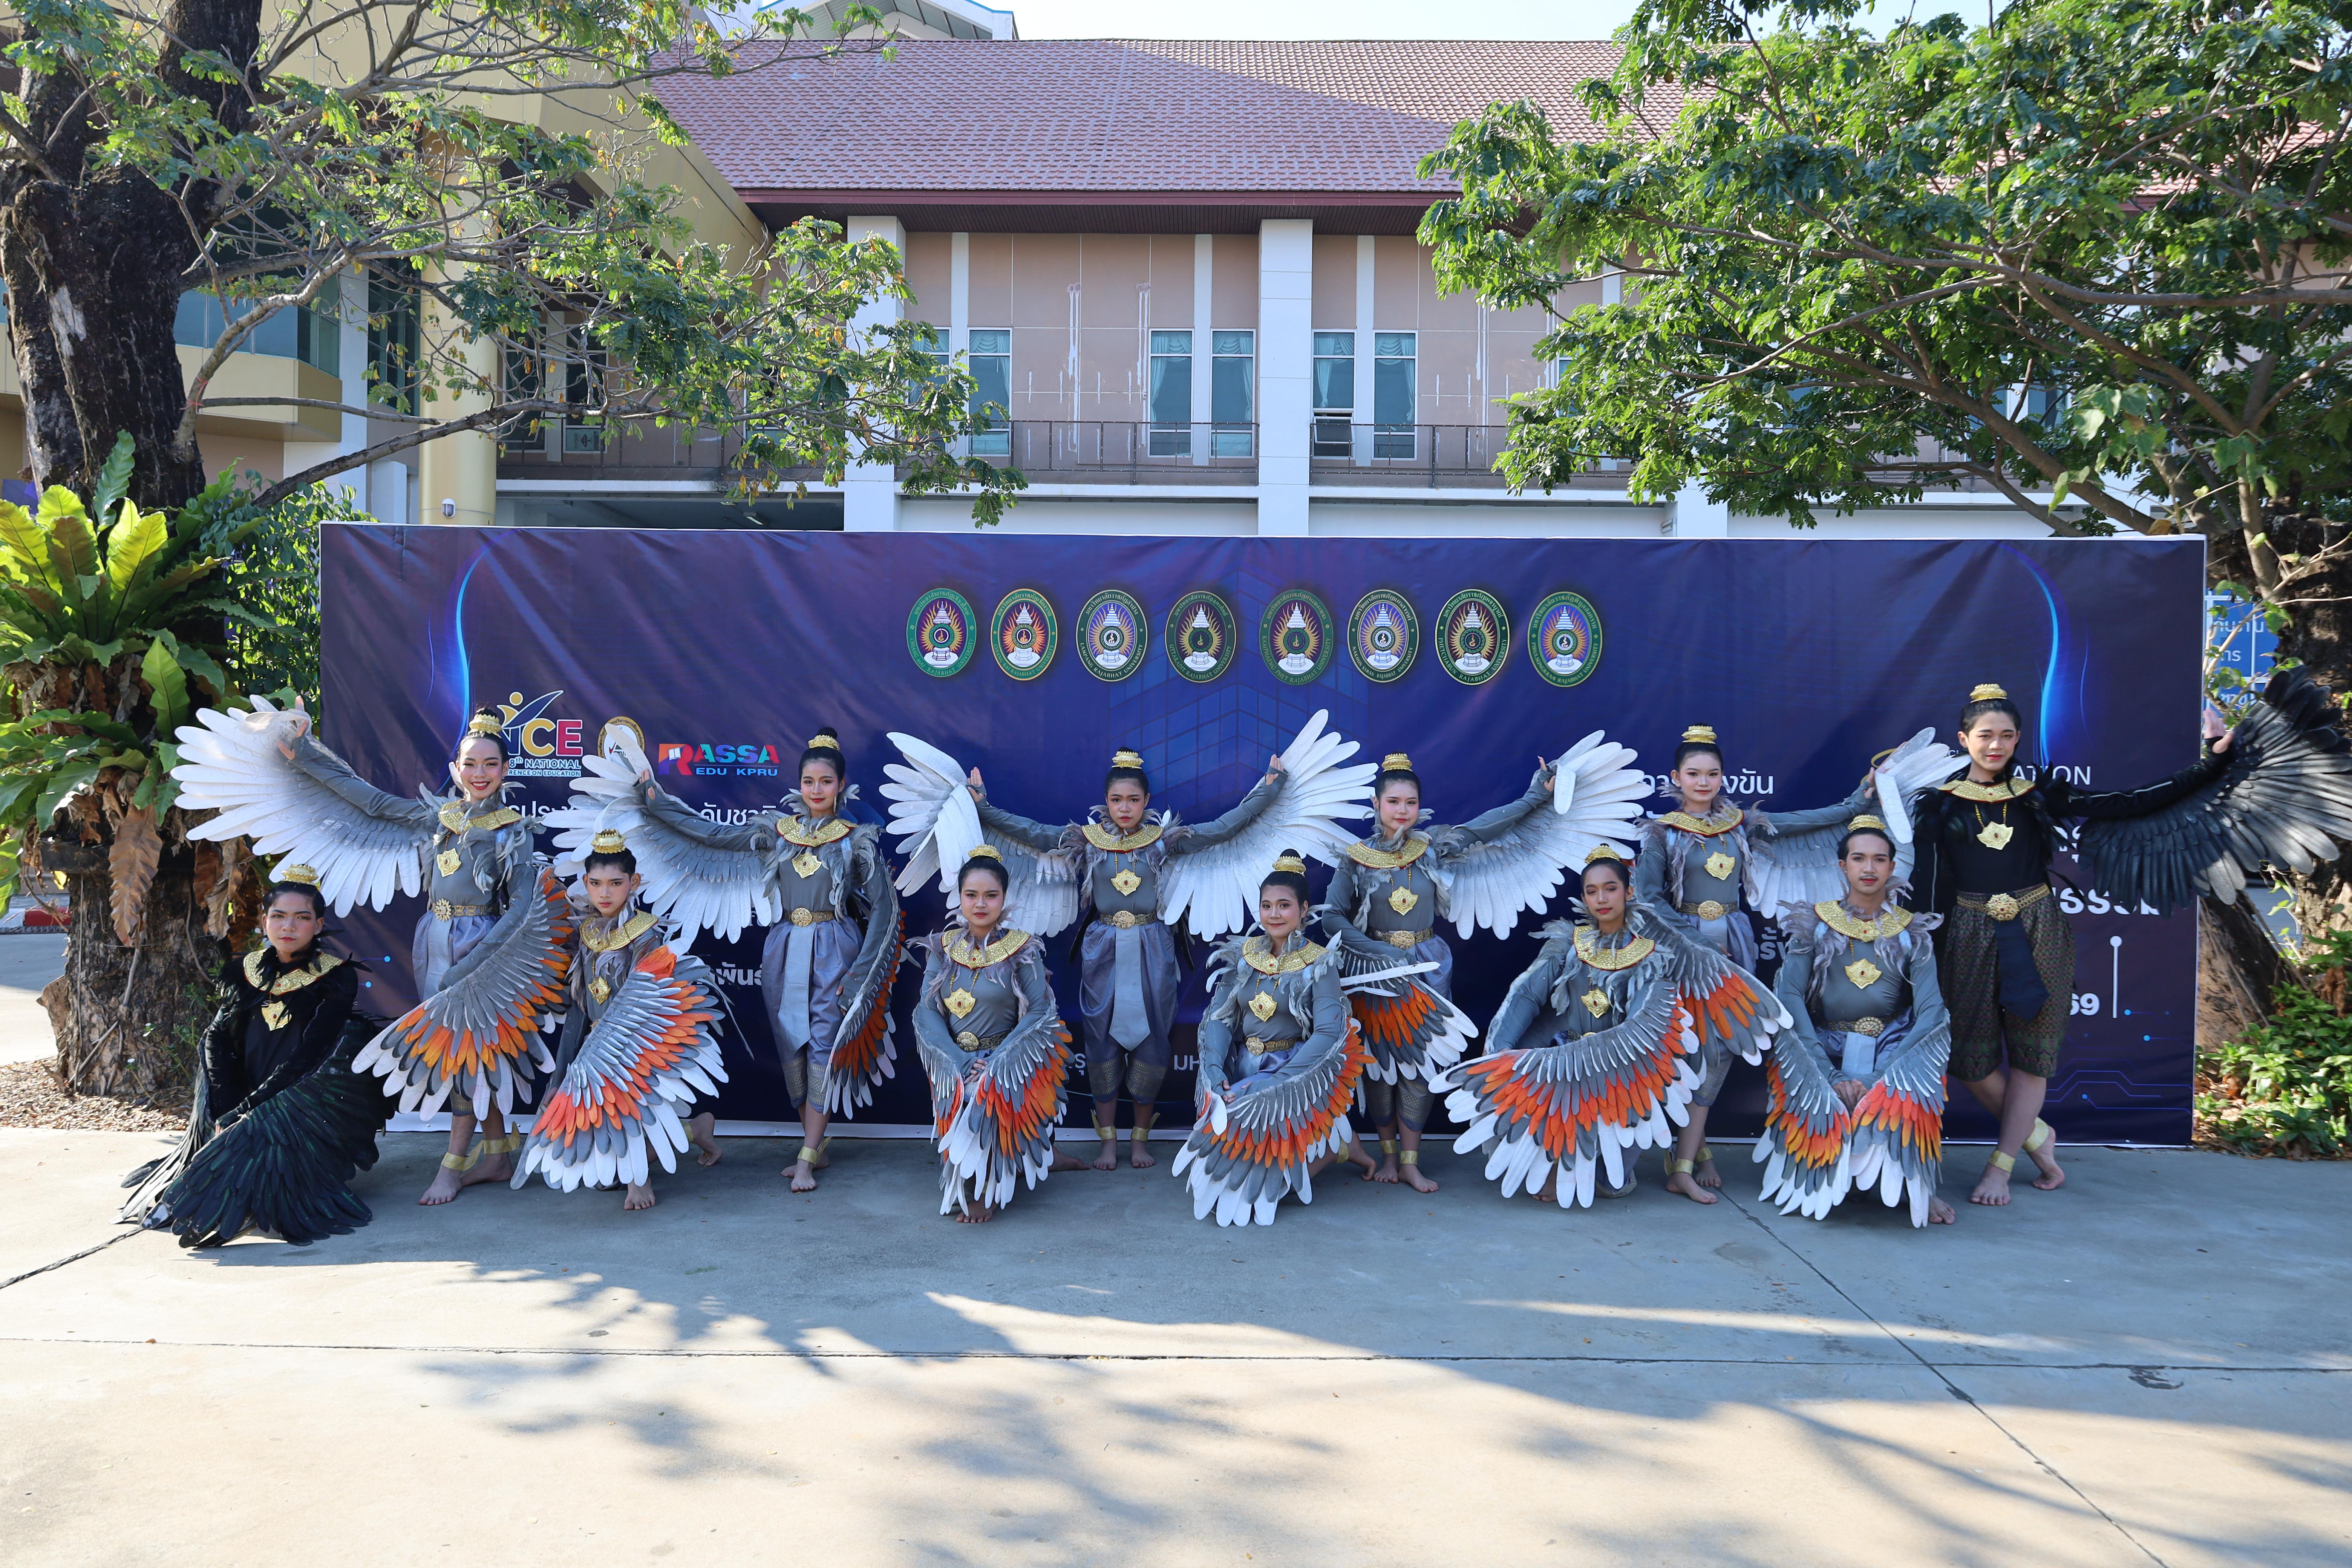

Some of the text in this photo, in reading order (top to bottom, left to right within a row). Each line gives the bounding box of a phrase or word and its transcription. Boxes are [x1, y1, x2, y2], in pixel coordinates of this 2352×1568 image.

[910, 638, 974, 676] CHIANG MAI RAJABHAT UNIVERSITY
[994, 644, 1004, 664] CHIANG
[1036, 645, 1054, 671] UNIVERSITY
[1080, 643, 1143, 678] LAMPANG RAJABHAT UNIVERSITY
[1169, 644, 1232, 680] UTTARADIT RAJABHAT UNIVERSITY
[1262, 635, 1331, 684] KAMPHAENG PHET RAJABHAT UNIVERSITY
[1352, 646, 1413, 679] NAKHON SAWAN RAJABHAT UNIVERSITY
[1438, 638, 1507, 682] PHETCHABUN RAJABHAT UNIVERSITY
[1557, 673, 1583, 684] RAJABHAT
[1583, 643, 1599, 674] UNIVERSITY
[525, 759, 582, 769] NATIONAL
[658, 743, 780, 775] RASSA
[737, 768, 778, 776] KPRU
